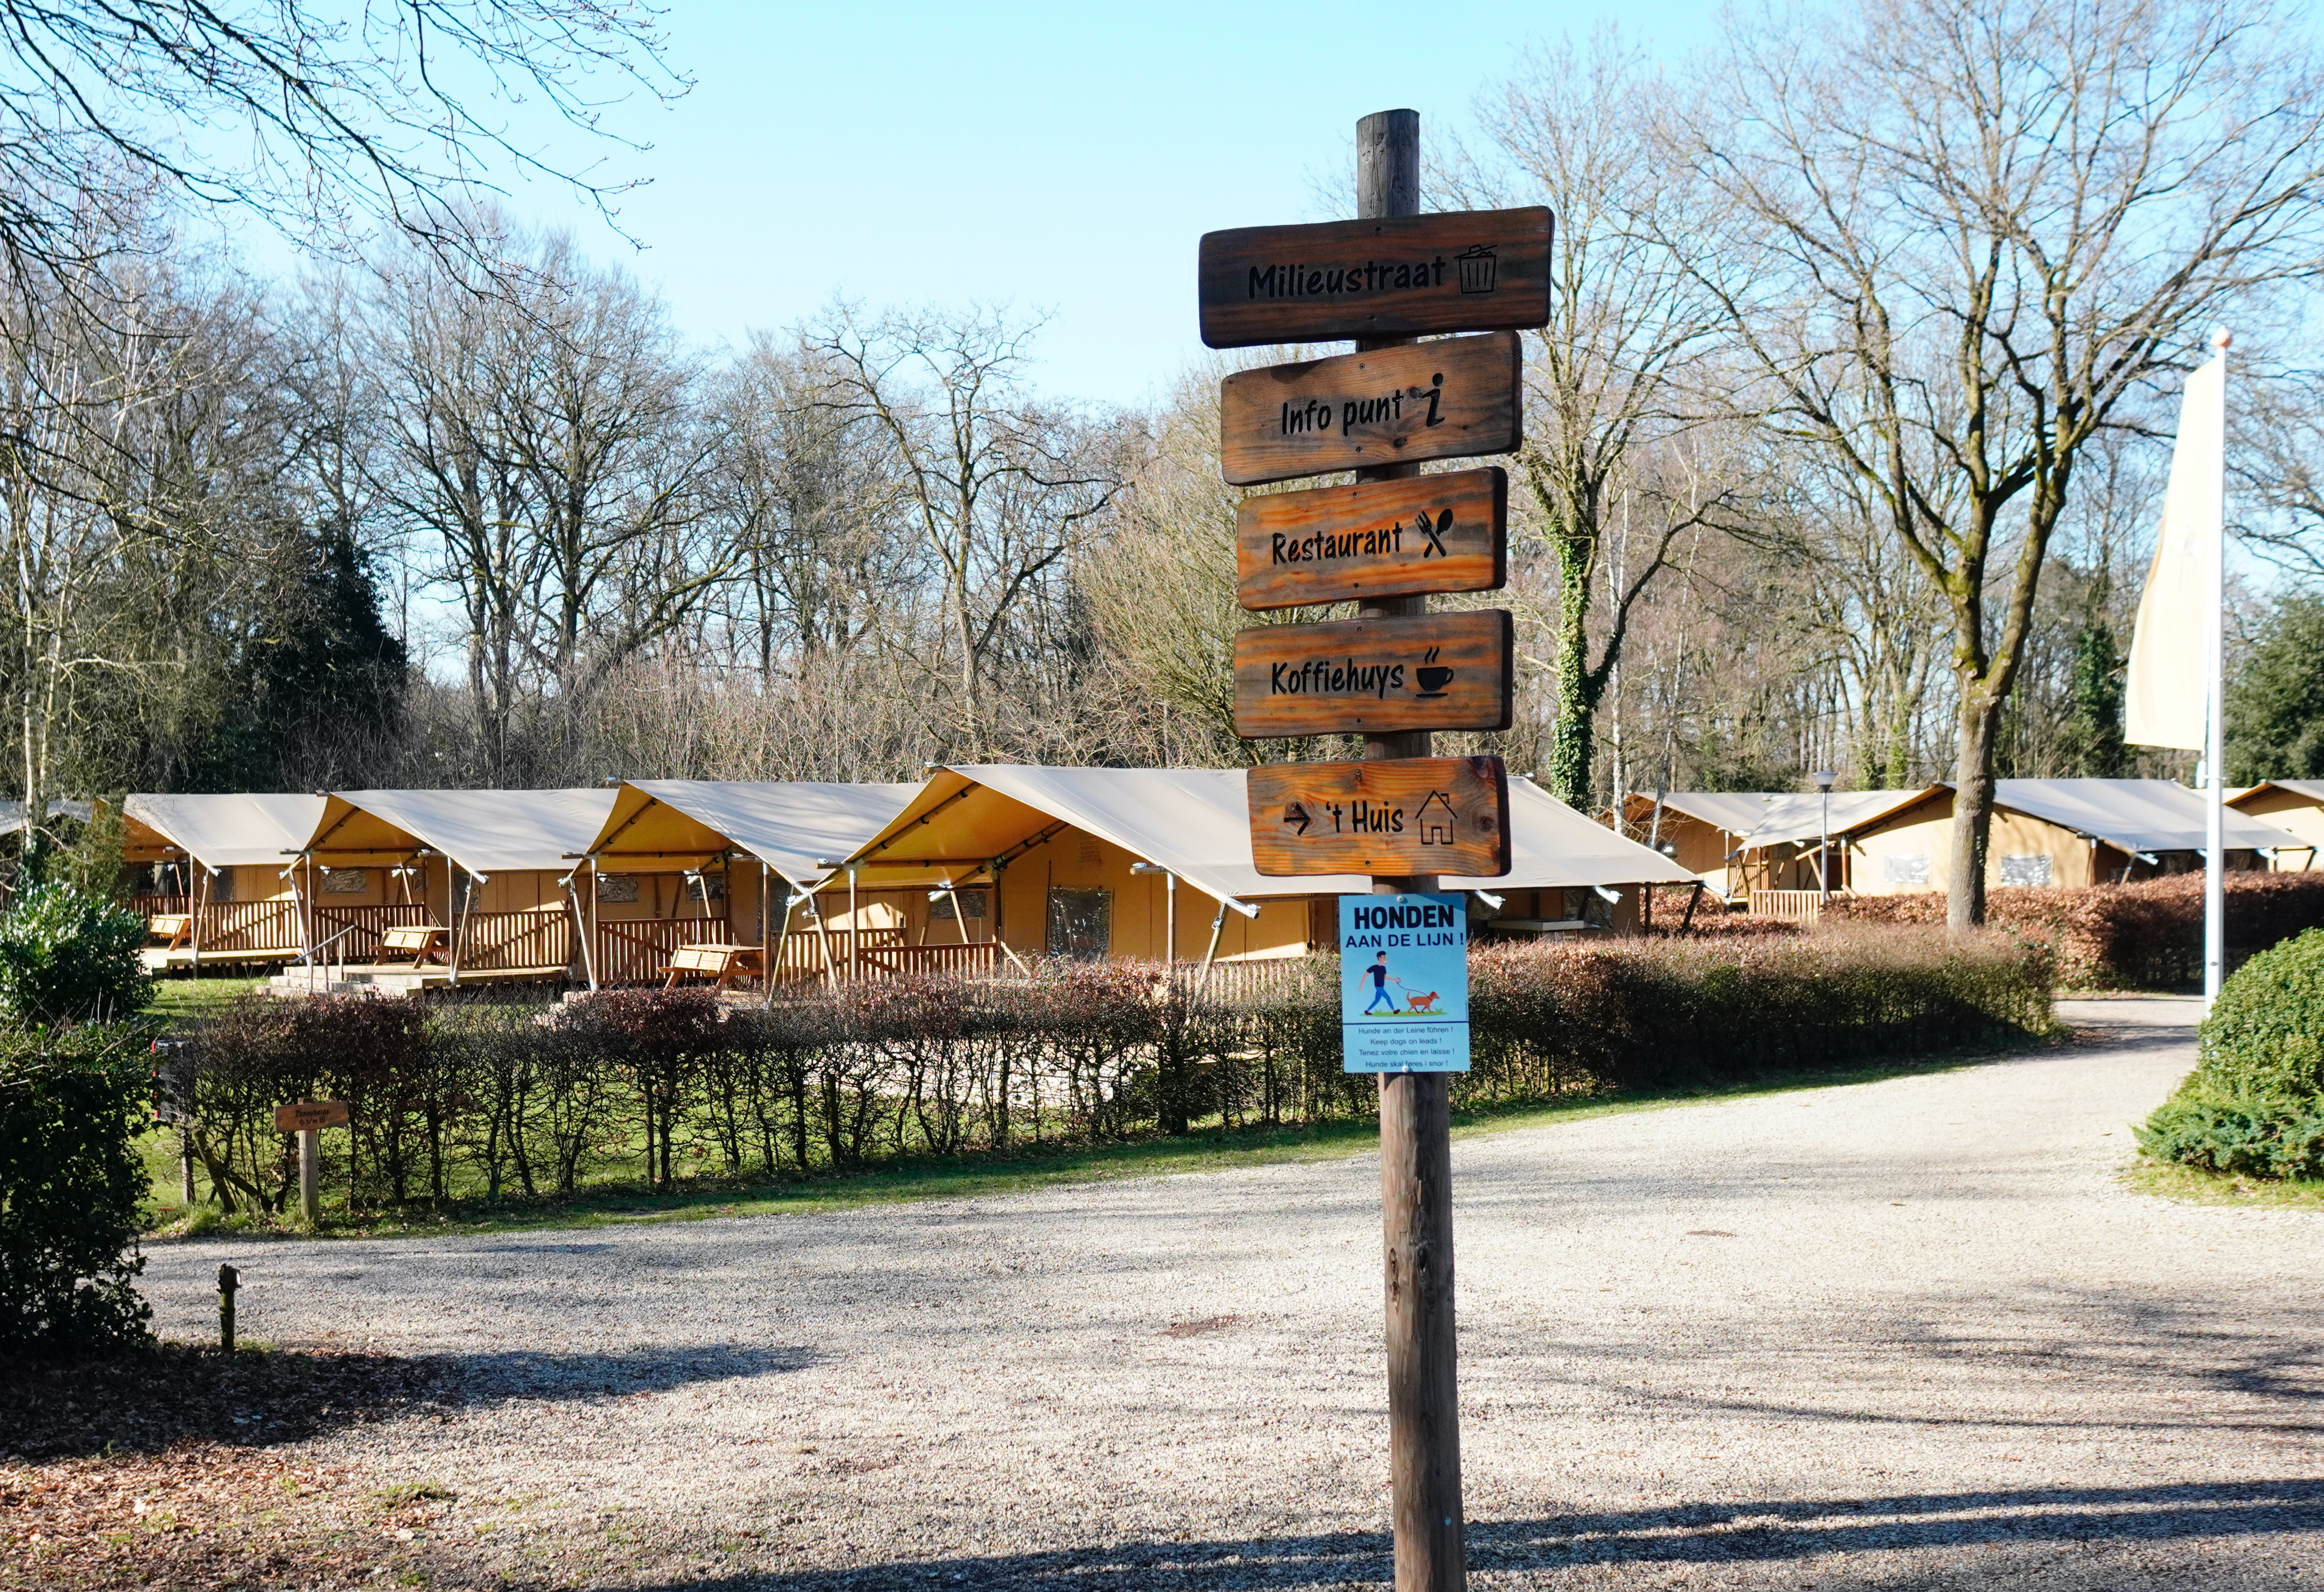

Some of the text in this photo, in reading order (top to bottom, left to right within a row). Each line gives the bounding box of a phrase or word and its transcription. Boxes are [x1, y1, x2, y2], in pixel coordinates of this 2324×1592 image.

[1249, 255, 1445, 299] Milieustraat
[1281, 400, 1331, 435] Info
[1343, 390, 1403, 436] punt
[1272, 522, 1403, 564] Restaurant
[1272, 658, 1403, 699] Koffiehuys
[1352, 800, 1403, 833] Huis
[1354, 905, 1454, 930] HONDEN
[1346, 934, 1381, 948] AAN
[1388, 934, 1410, 946] DE
[1417, 933, 1453, 946] LIJN
[295, 1108, 330, 1117] Zonneheide
